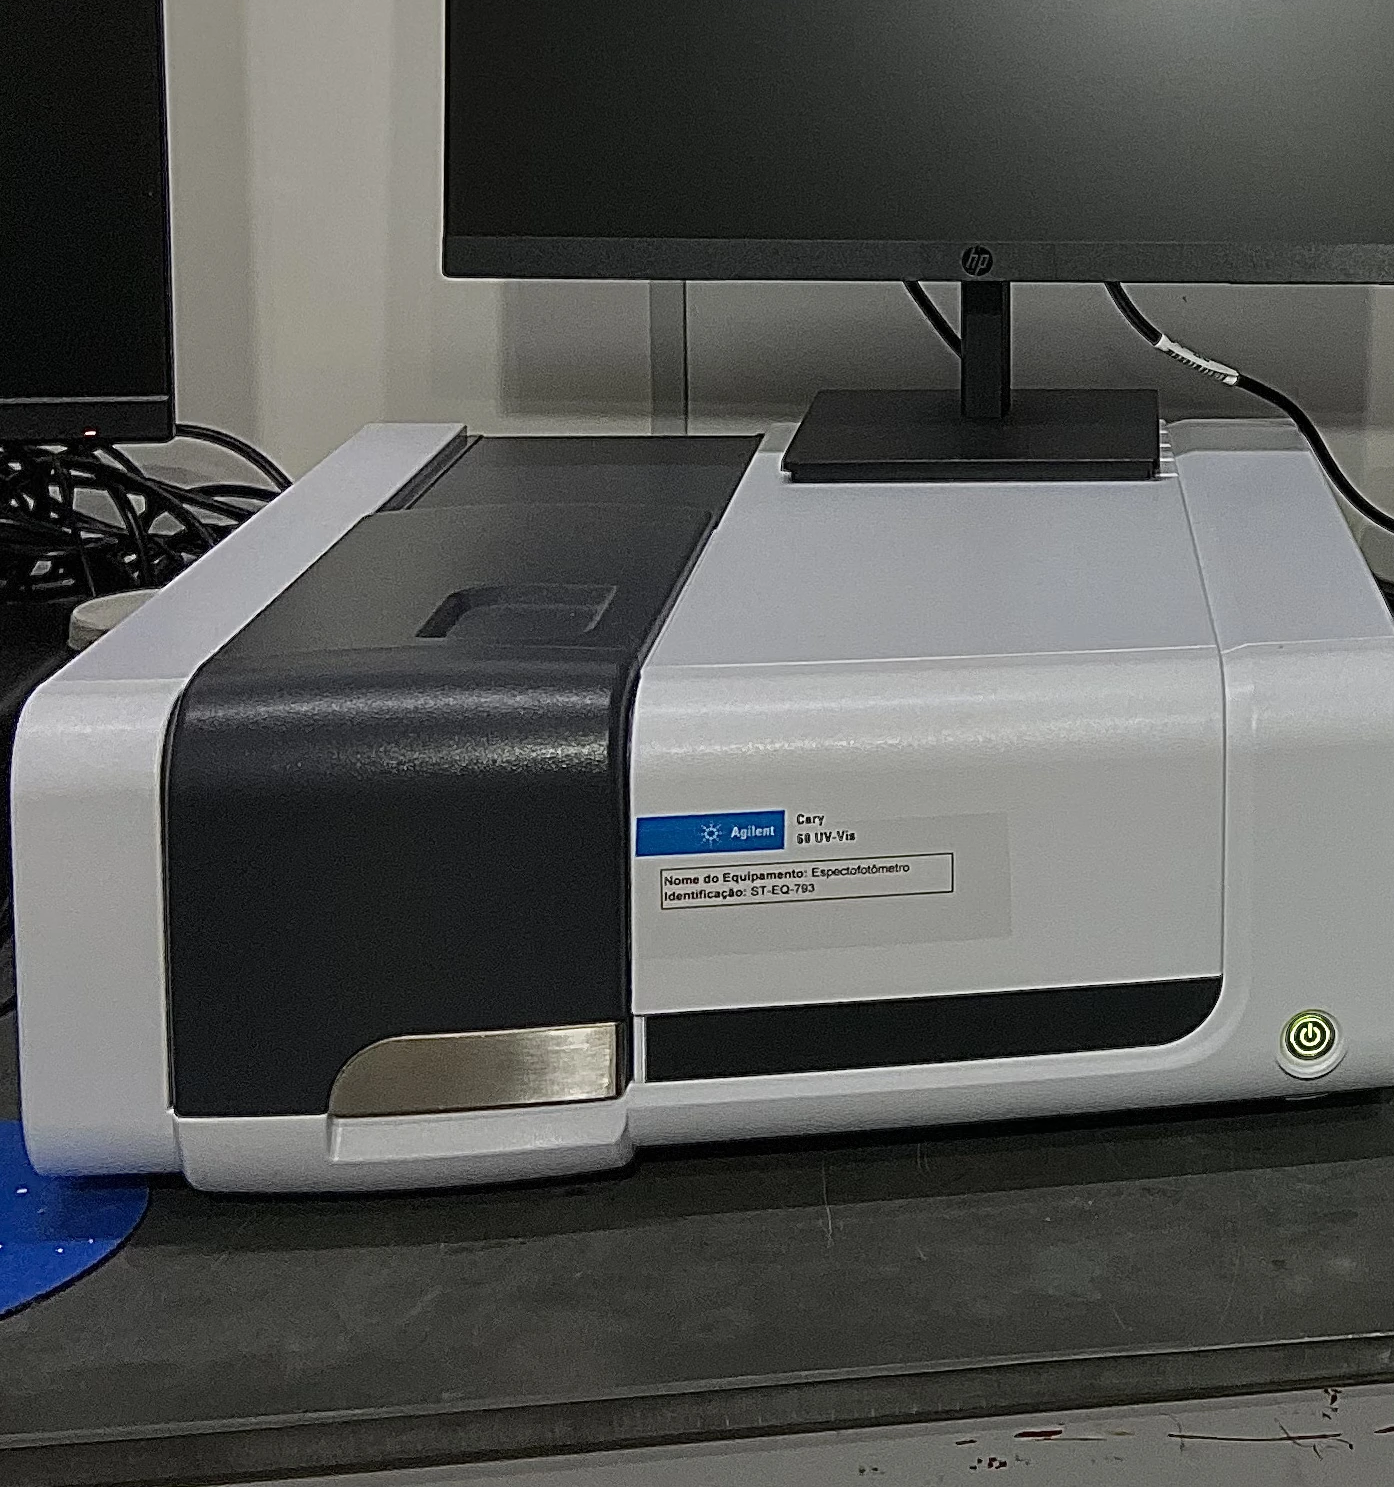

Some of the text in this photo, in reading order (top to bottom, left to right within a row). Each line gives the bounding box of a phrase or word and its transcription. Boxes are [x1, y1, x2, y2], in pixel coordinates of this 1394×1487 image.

[965, 247, 990, 275] hp
[796, 814, 825, 826] Cary
[730, 825, 775, 840] Agilent
[796, 830, 856, 844] 60 UV-Vis
[664, 876, 700, 886] Nome
[703, 874, 719, 884] do
[722, 869, 808, 883] Equipamento:
[664, 884, 815, 901] Identificação: ST-EQ-793
